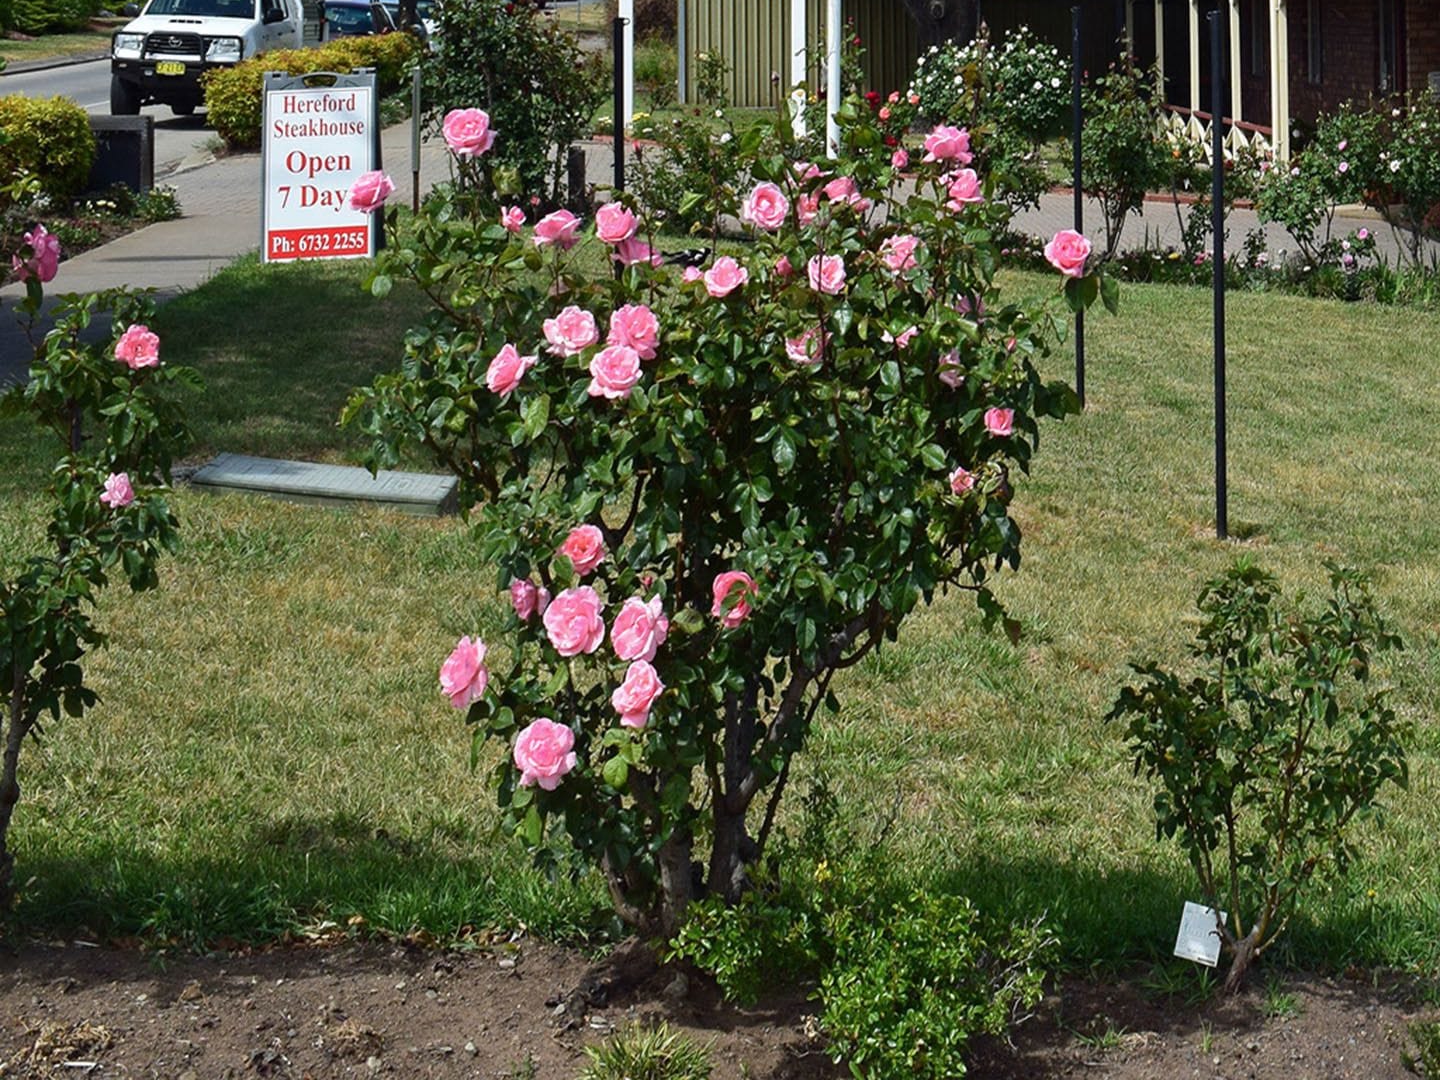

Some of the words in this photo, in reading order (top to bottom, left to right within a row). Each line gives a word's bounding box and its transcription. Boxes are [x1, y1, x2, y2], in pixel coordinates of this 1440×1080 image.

[283, 93, 355, 114] Hereford
[273, 119, 364, 139] Steakhouse
[286, 150, 351, 178] Open
[278, 186, 290, 209] 7
[300, 185, 348, 212] Day
[272, 236, 295, 253] Ph:
[299, 233, 330, 252] 6732
[334, 232, 364, 250] 2255
